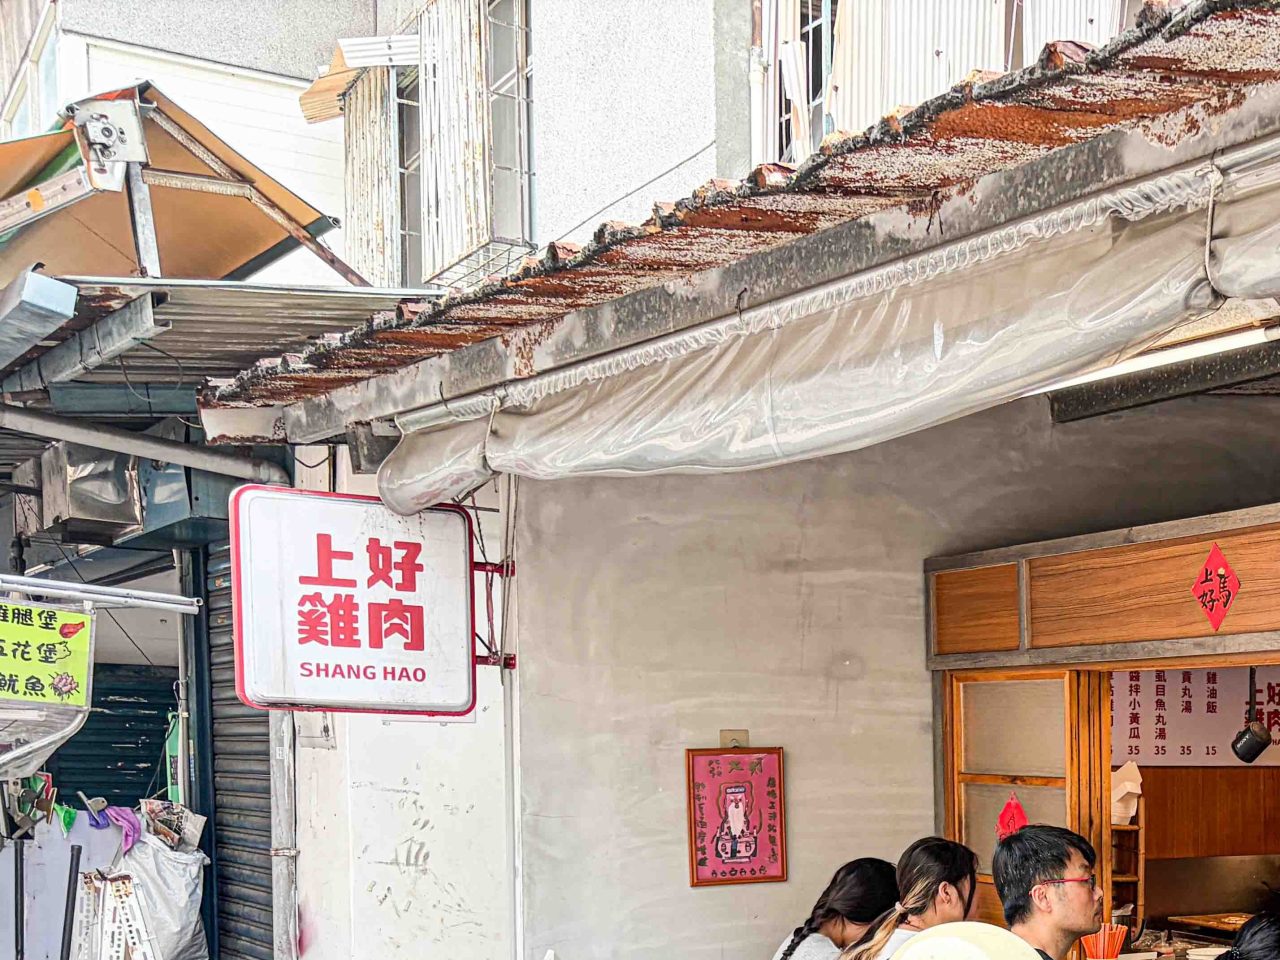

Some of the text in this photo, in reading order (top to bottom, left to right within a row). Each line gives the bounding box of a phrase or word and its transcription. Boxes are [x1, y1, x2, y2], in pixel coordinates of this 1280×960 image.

[299, 533, 423, 592] 上好
[298, 592, 425, 651] 雞肉
[300, 662, 427, 683] SHANG HAO
[1181, 671, 1192, 714] 貢丸湯
[1206, 671, 1217, 714] 雞油飯
[1127, 745, 1140, 756] 35
[1154, 745, 1166, 756] 35
[1180, 745, 1192, 756] 35
[1205, 745, 1217, 756] 15
